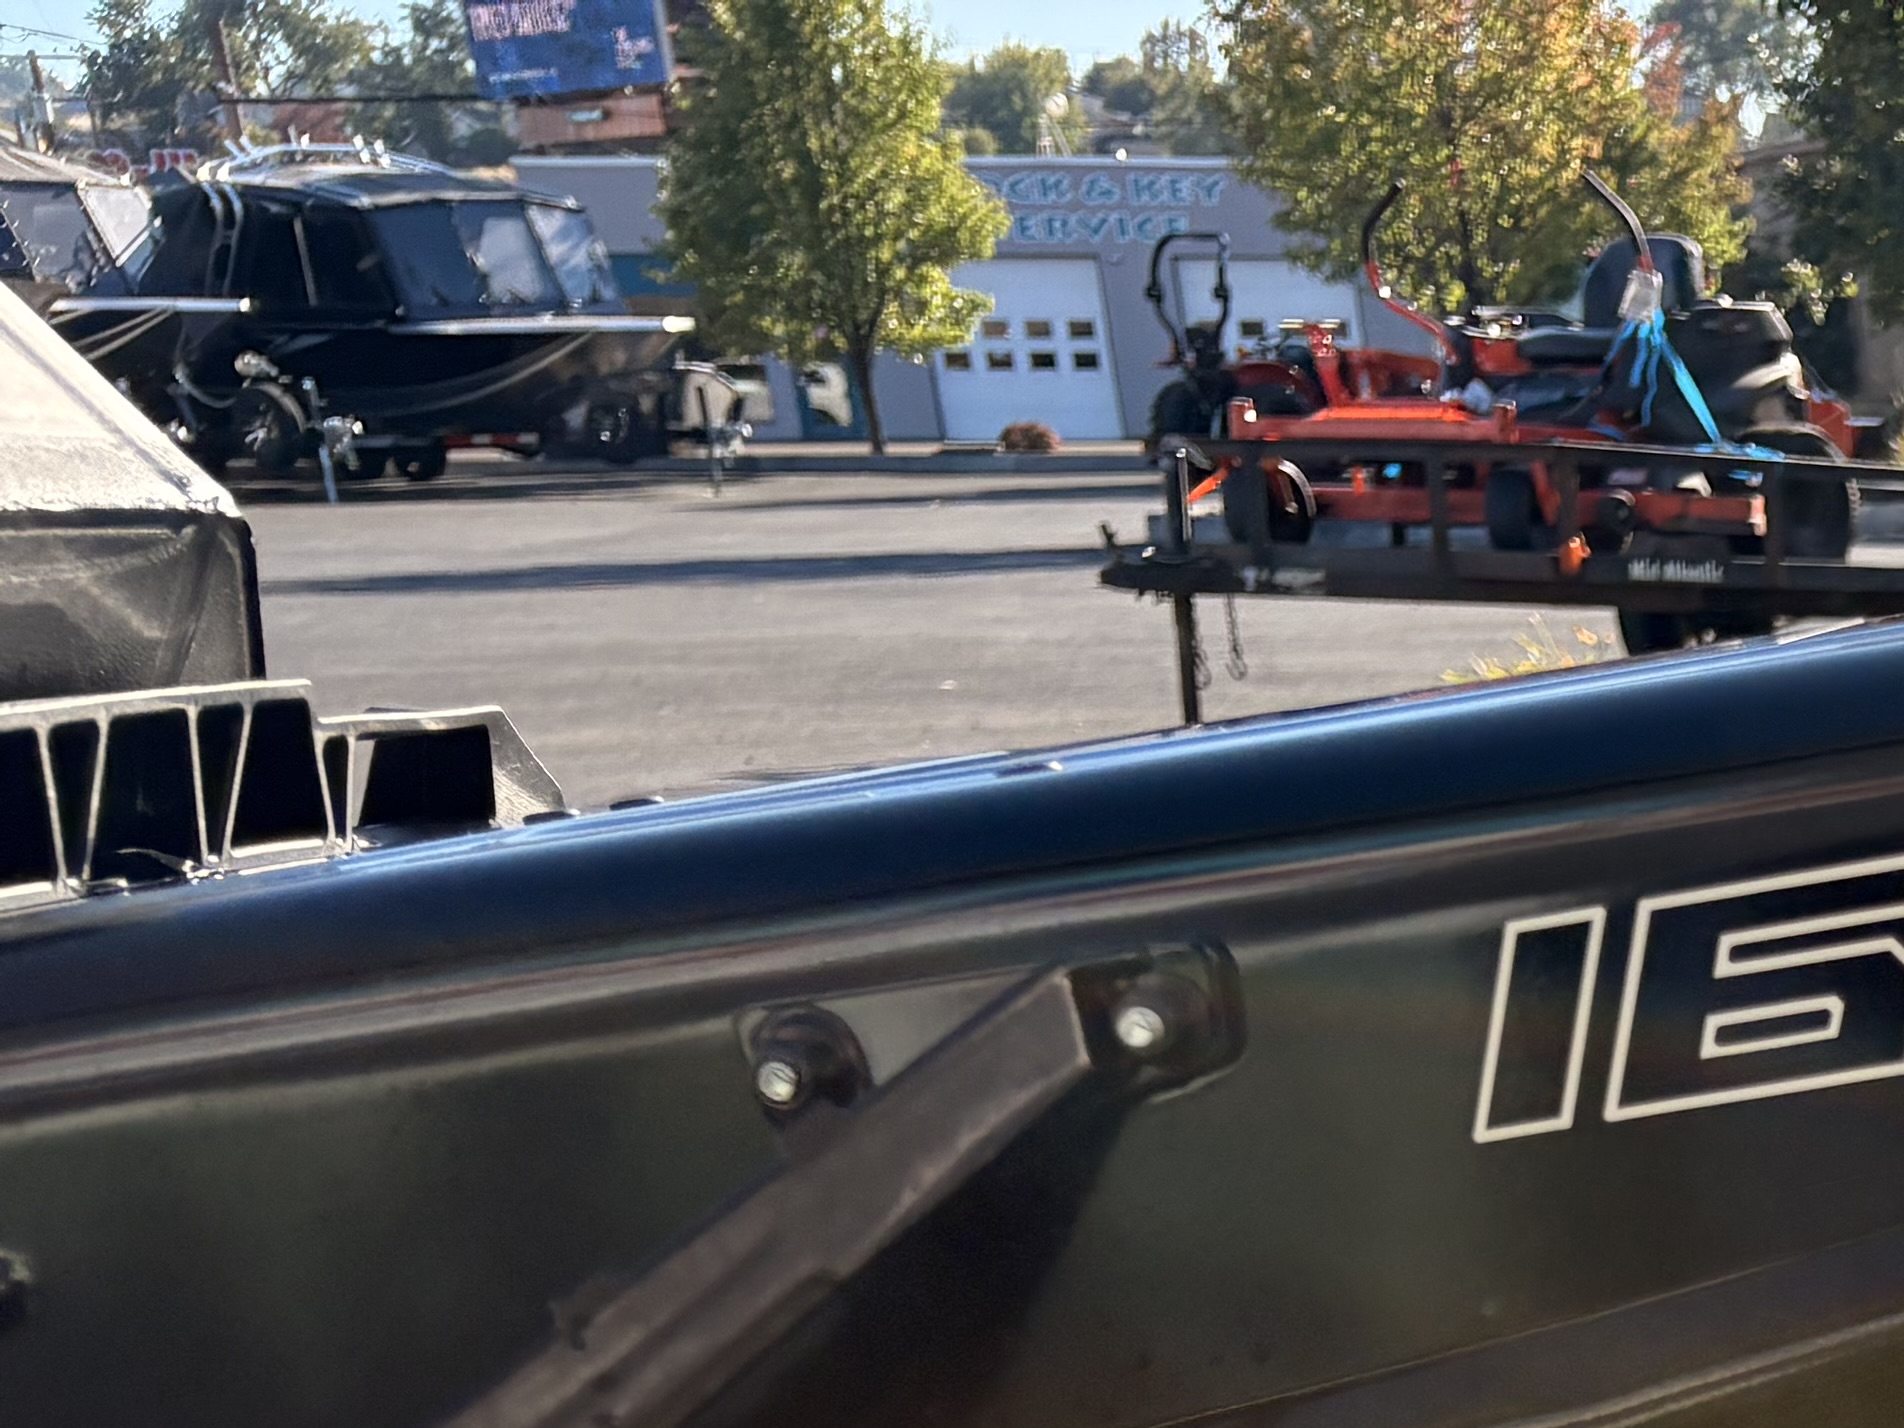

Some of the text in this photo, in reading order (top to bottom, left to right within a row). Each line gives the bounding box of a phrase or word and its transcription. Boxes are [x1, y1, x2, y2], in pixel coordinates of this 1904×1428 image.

[1078, 170, 1121, 205] &
[1125, 170, 1227, 208] KEY
[1008, 208, 1190, 244] ERVICE
